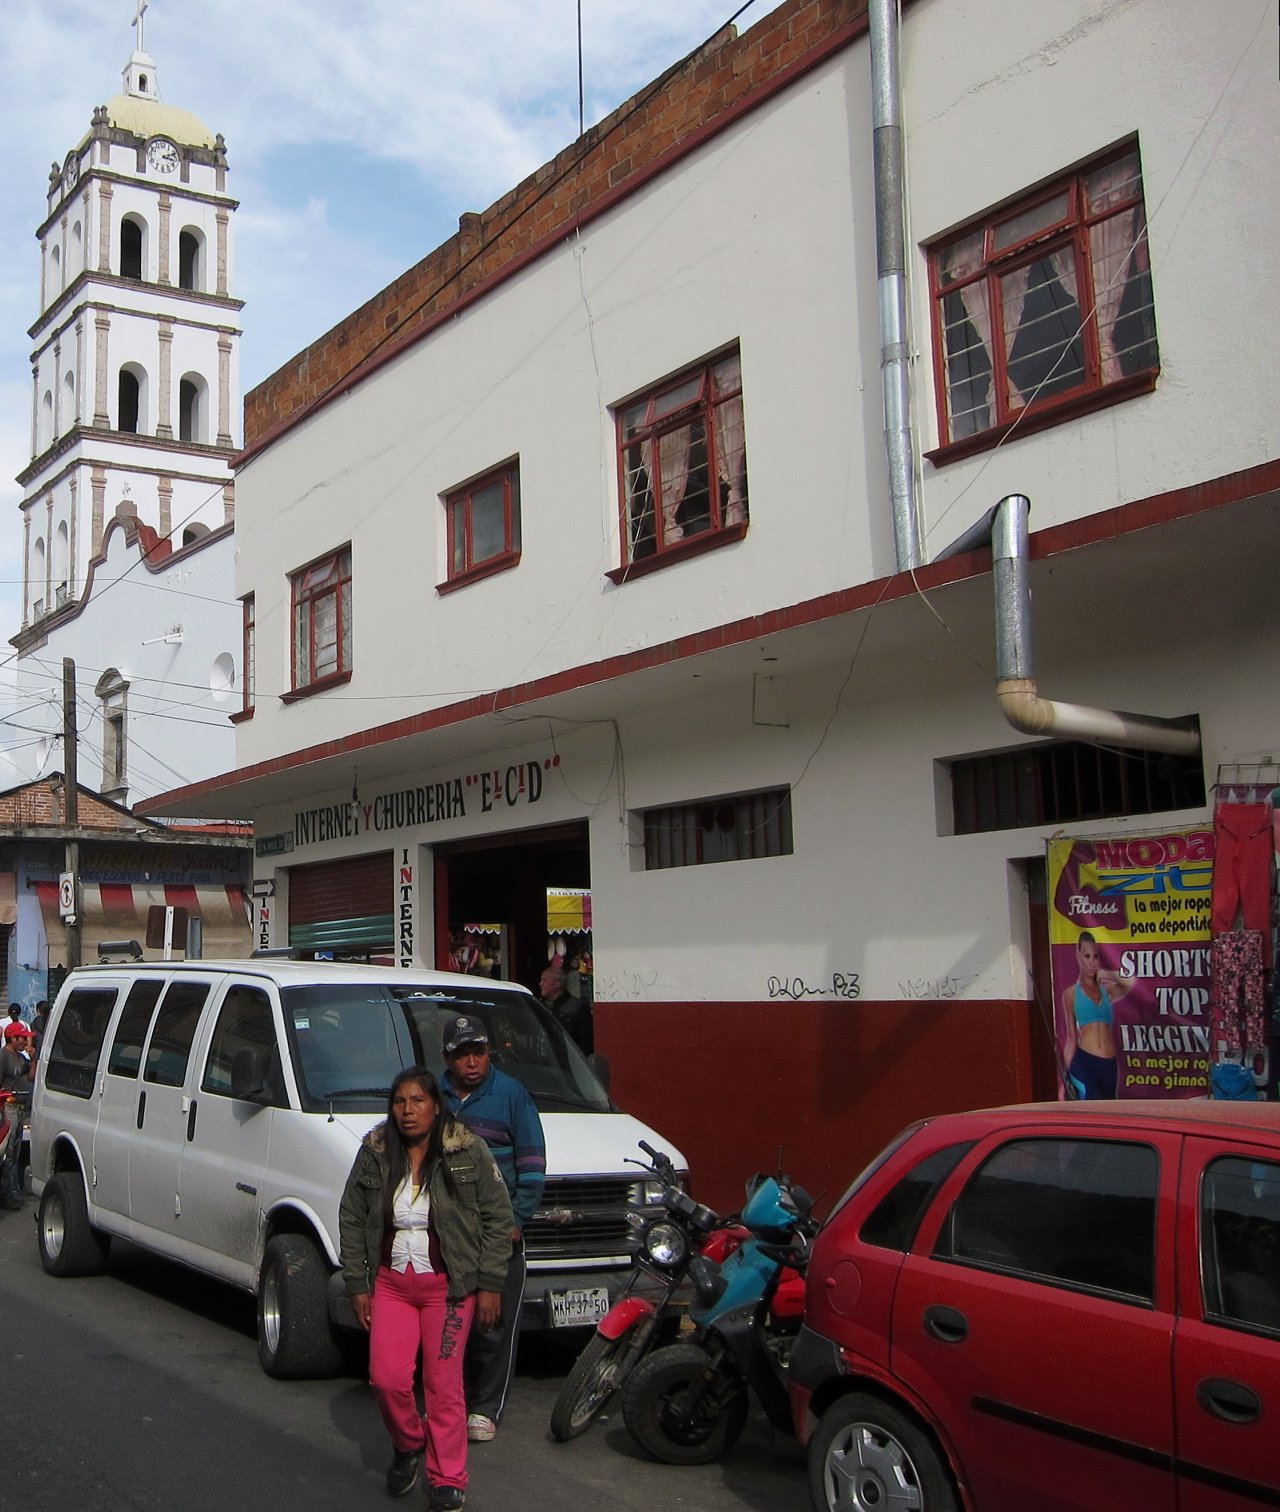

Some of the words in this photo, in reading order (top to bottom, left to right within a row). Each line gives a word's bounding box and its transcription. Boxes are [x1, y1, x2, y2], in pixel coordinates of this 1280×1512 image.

[362, 805, 373, 831] Y
[373, 778, 467, 832] CHURRERIA
[80, 872, 141, 882] ACCESORIOS
[156, 873, 186, 883] PLATA
[1068, 895, 1118, 915] Fitness
[1134, 898, 1147, 913] la
[1149, 895, 1182, 915] mejor
[1184, 897, 1211, 913] ropa
[259, 897, 271, 950] INTE
[1130, 921, 1157, 937] para
[1155, 987, 1209, 1015] TOP
[1126, 1055, 1141, 1068] la
[1145, 1055, 1188, 1072] mejor
[1125, 1074, 1160, 1087] para
[552, 1298, 607, 1317] MKH-37-50
